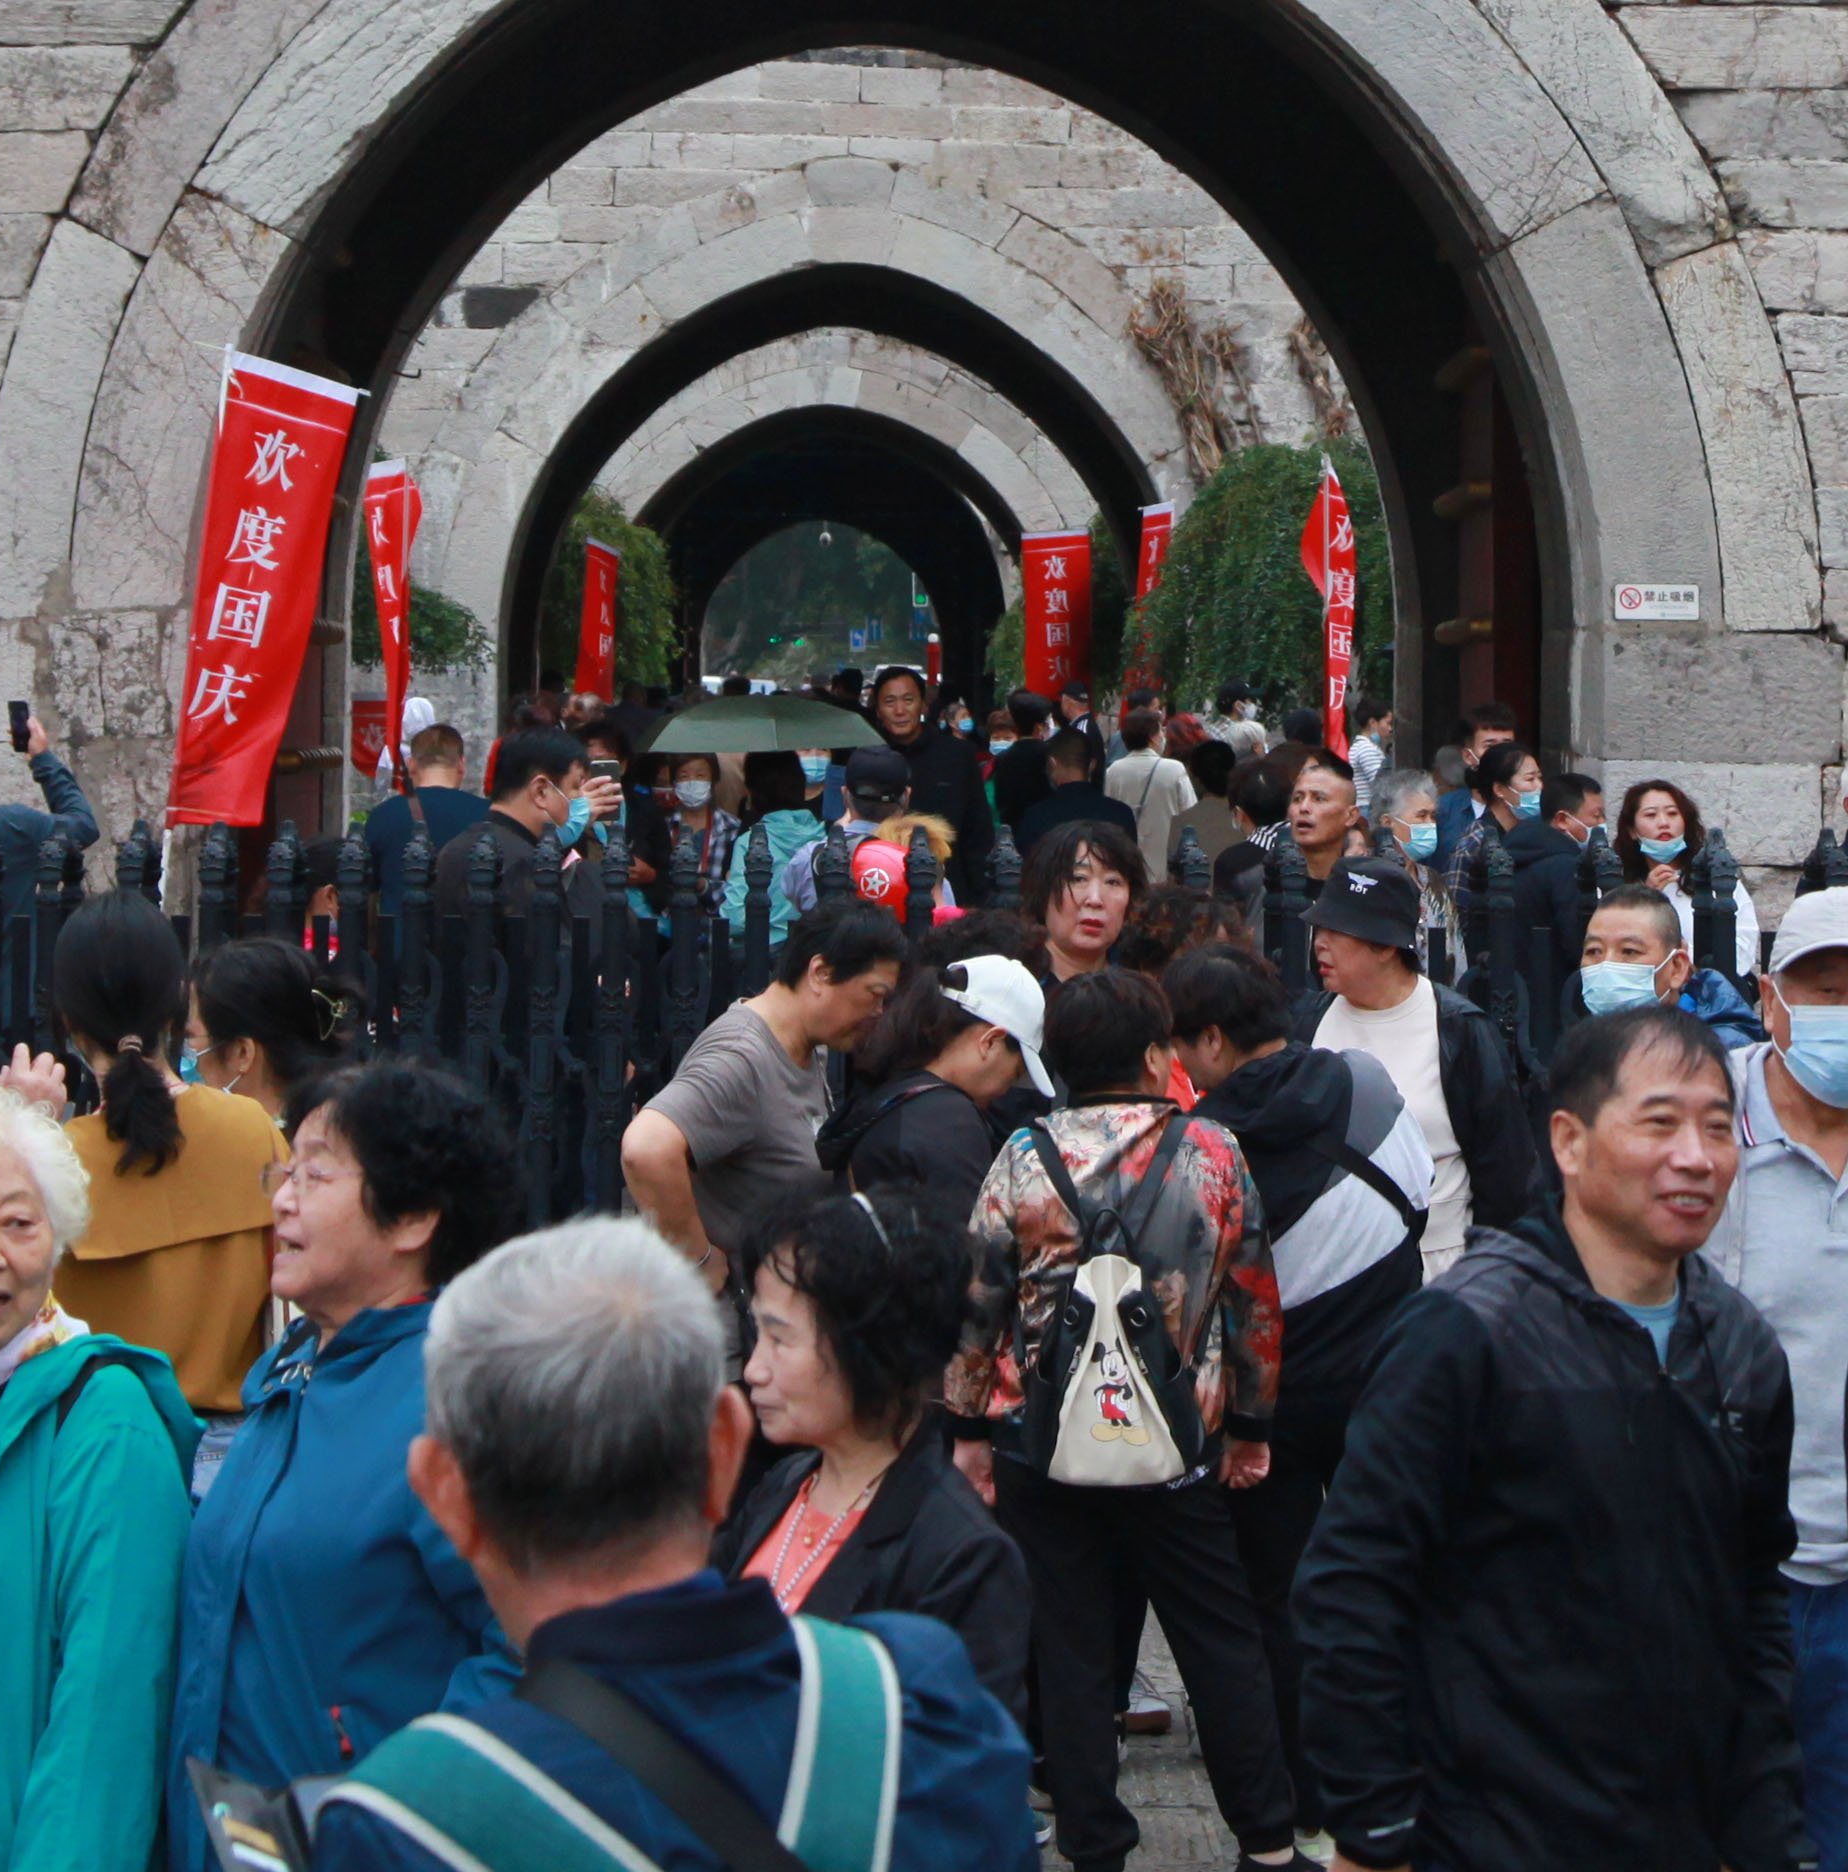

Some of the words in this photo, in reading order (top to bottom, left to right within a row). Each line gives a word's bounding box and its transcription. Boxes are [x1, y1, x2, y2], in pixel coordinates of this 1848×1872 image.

[187, 429, 301, 725] 欢度国庆
[1644, 590, 1695, 603] 禁止吸烟
